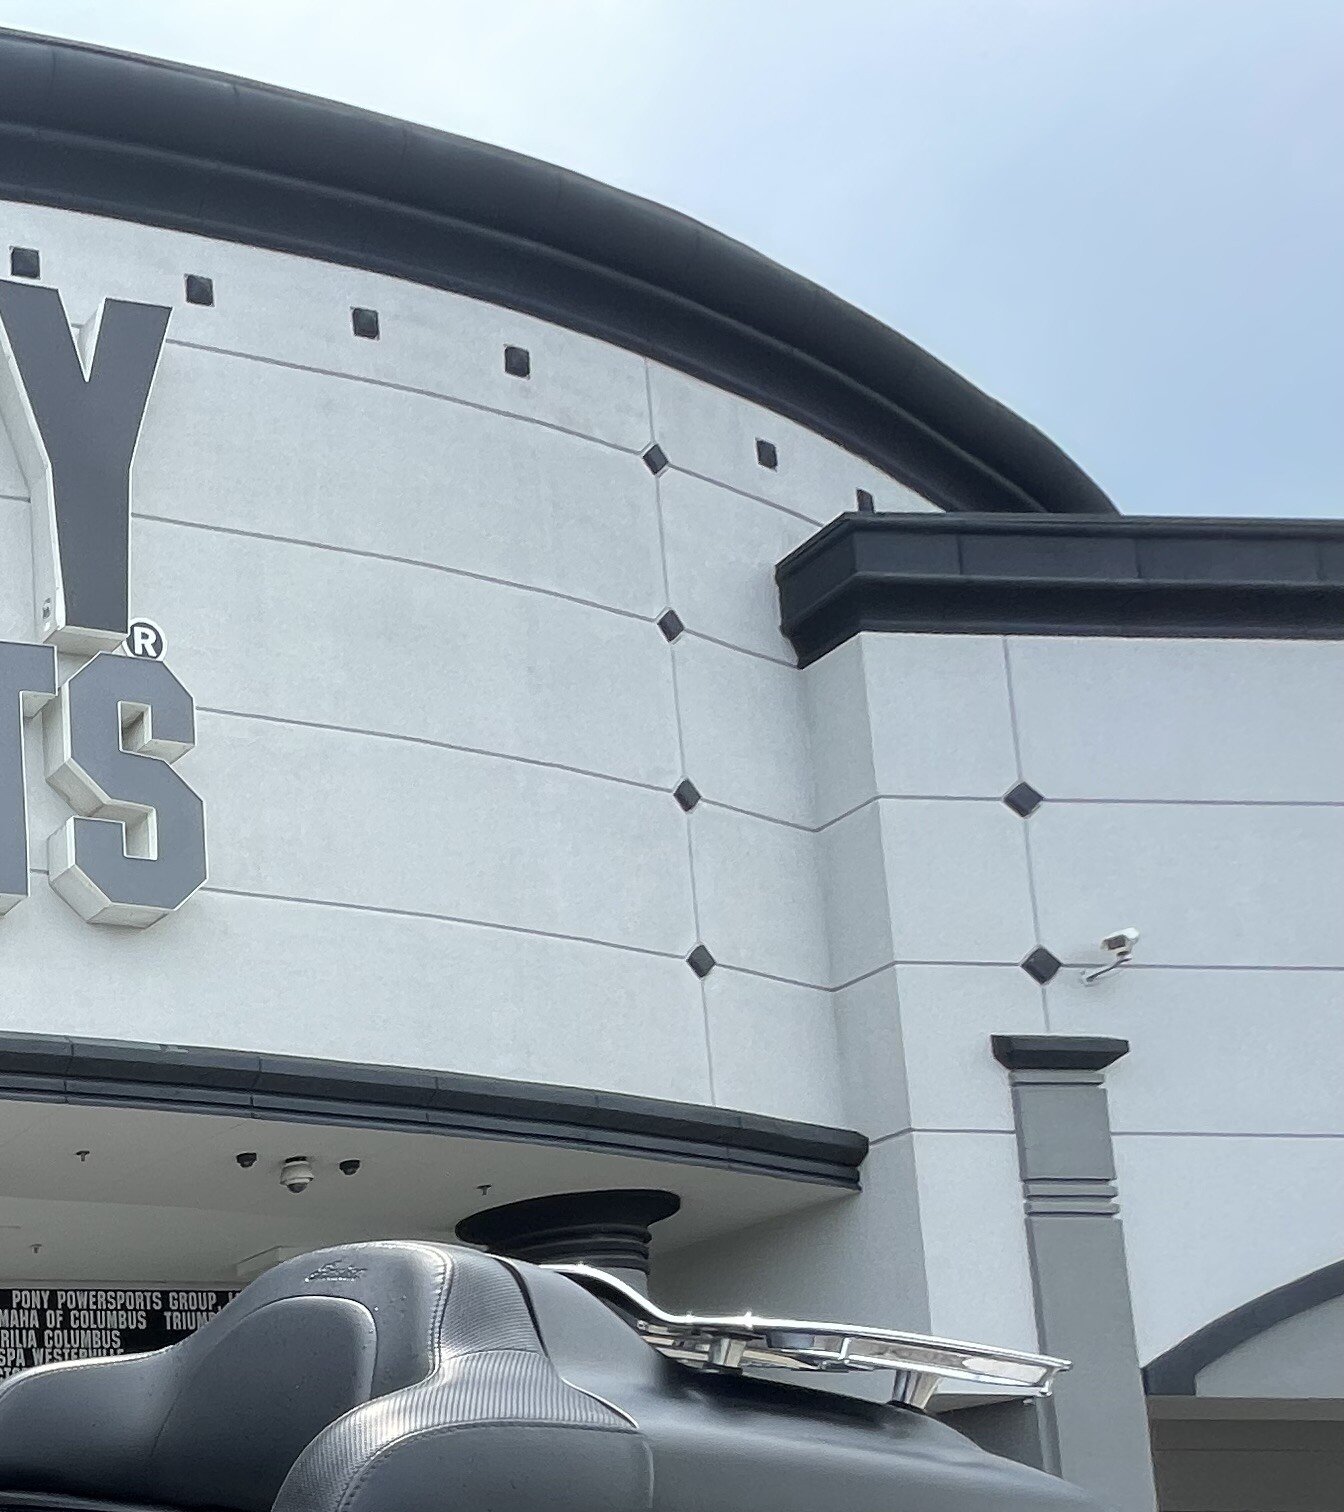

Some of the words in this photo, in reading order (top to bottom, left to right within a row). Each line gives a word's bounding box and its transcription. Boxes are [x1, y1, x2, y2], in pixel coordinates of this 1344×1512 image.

[12, 1291, 49, 1309] PONY
[58, 1291, 162, 1310] POWERSPORTS
[46, 1310, 63, 1328] OF
[71, 1310, 147, 1330] COLUMBUS
[44, 1330, 121, 1349] COLUMBUS
